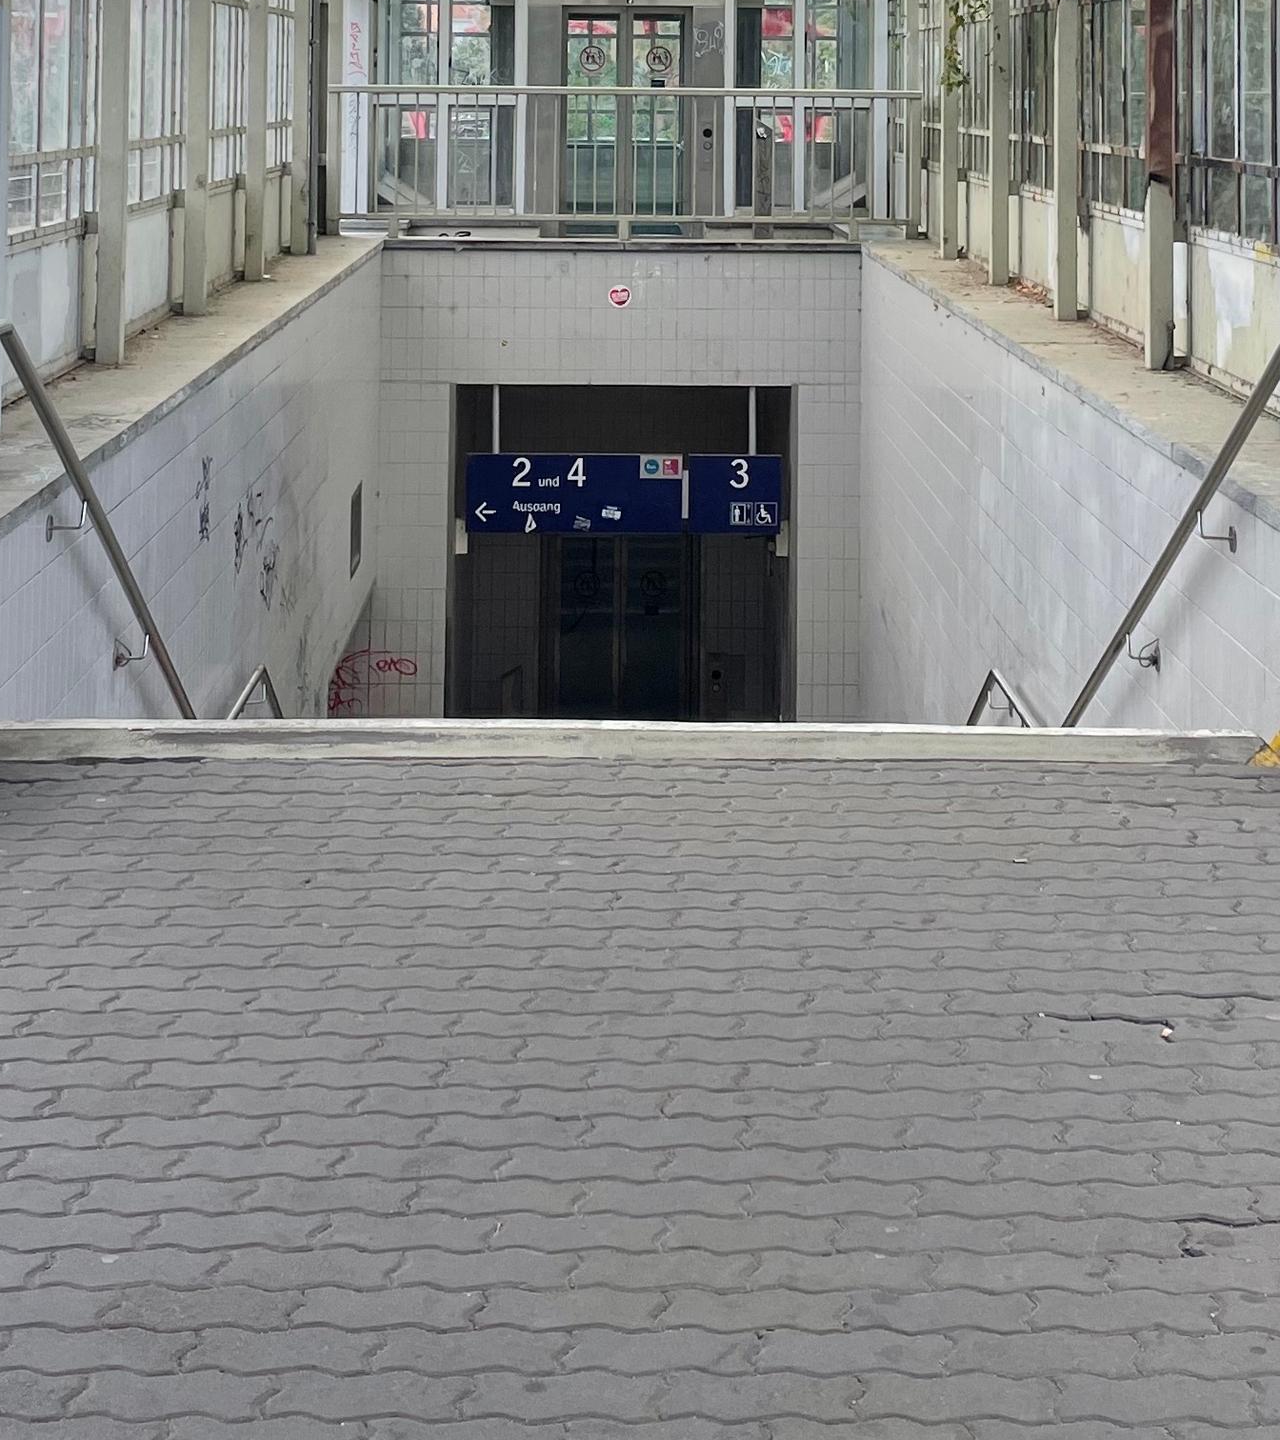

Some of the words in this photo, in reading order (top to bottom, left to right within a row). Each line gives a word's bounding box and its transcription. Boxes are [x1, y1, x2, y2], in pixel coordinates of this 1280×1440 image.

[511, 457, 531, 487] 2
[538, 475, 560, 488] und
[567, 457, 587, 487] 4
[729, 458, 750, 489] 3
